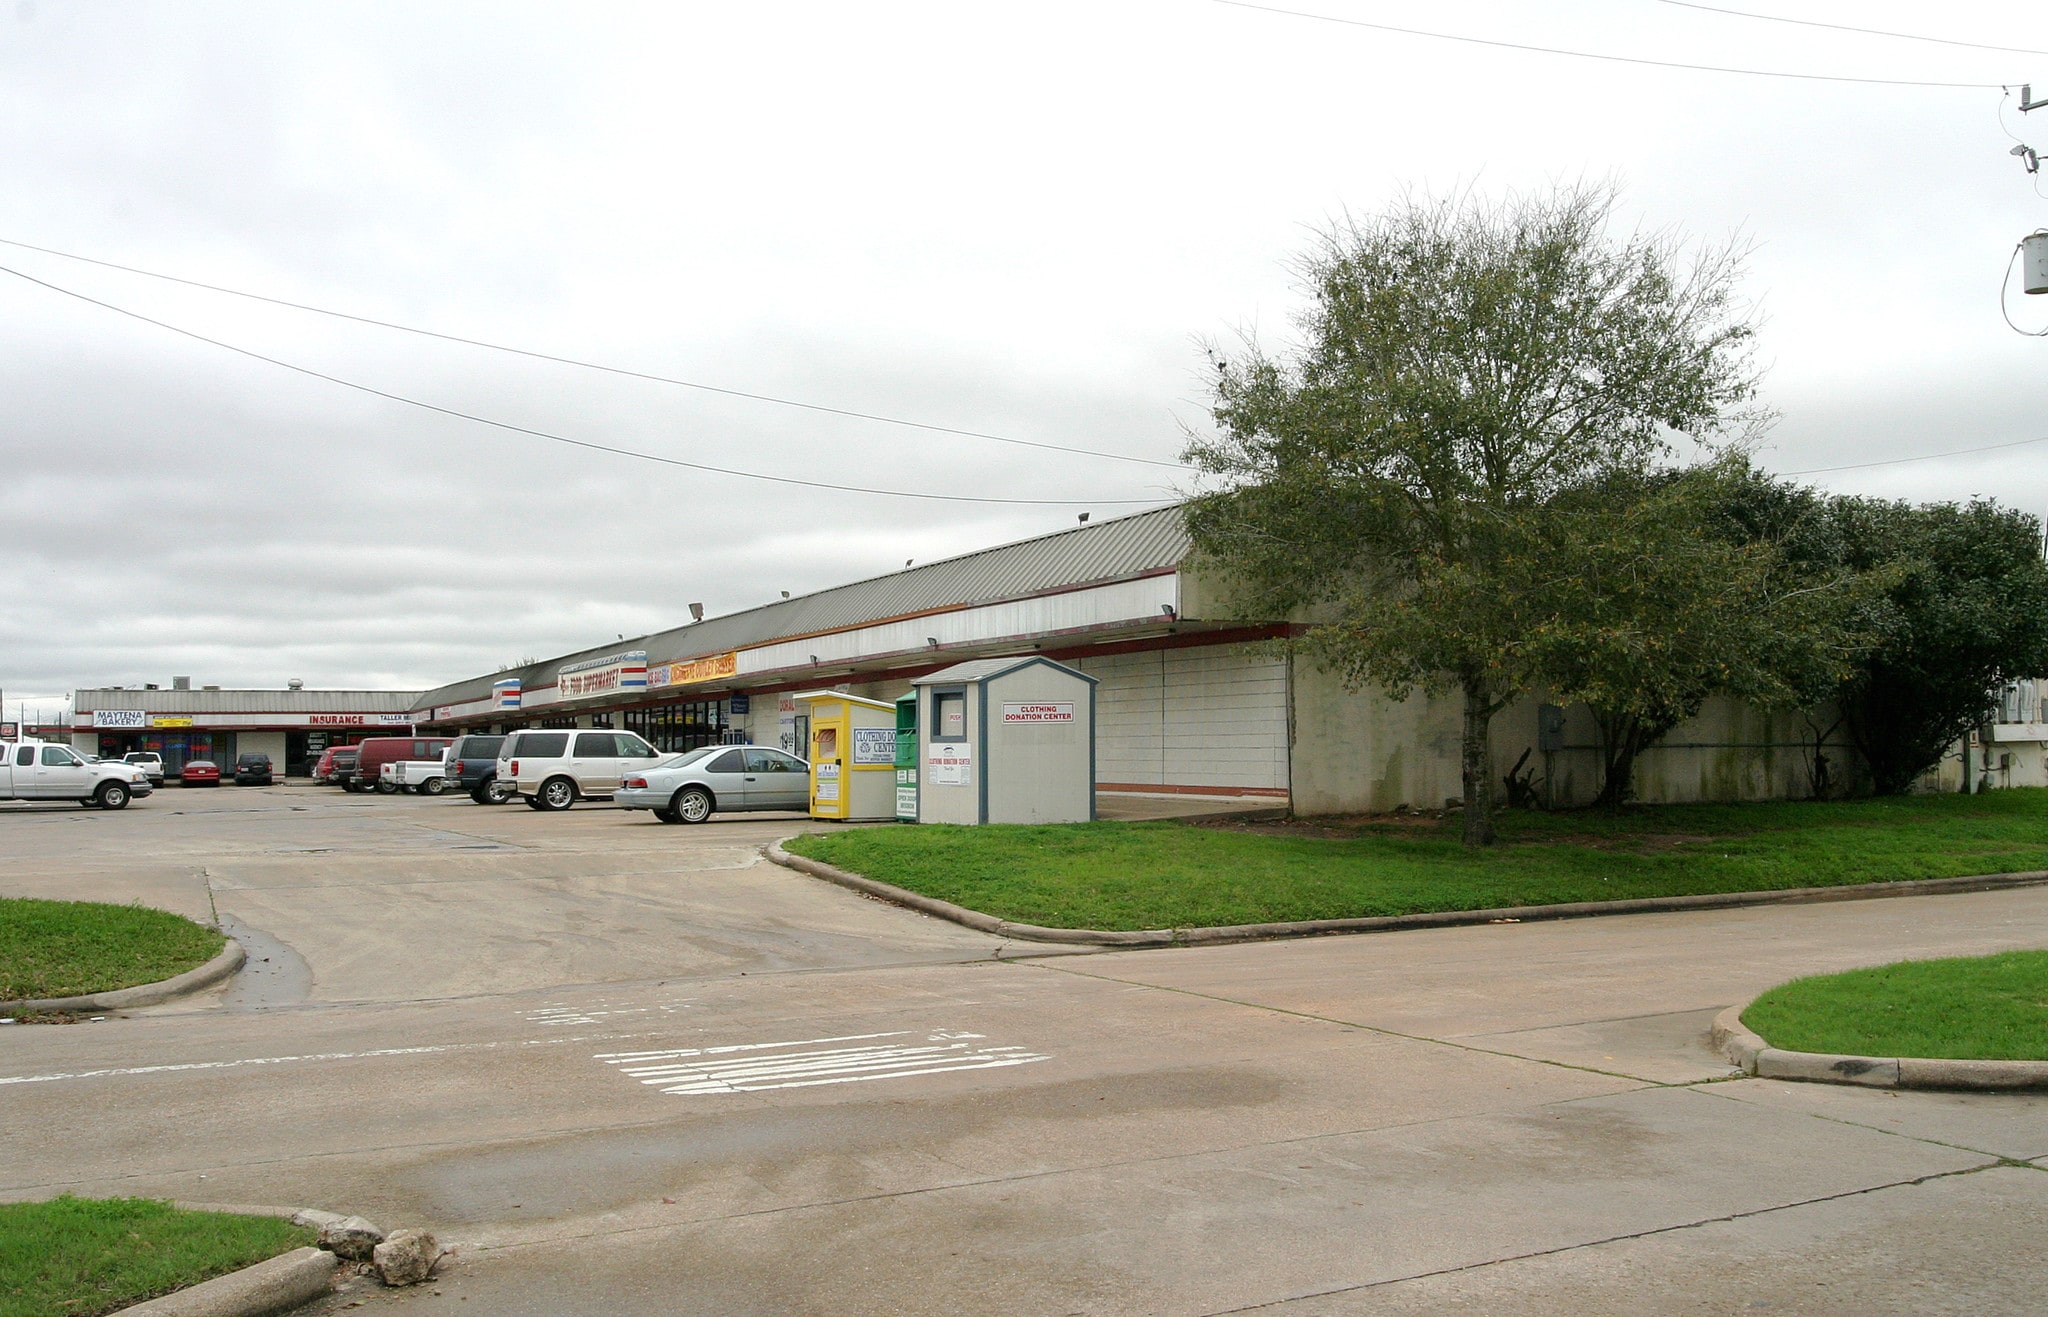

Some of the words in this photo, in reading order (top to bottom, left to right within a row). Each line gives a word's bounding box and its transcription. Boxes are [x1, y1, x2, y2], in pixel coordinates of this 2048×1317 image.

[780, 699, 794, 711] DORAL
[98, 711, 142, 719] MAYTENA
[309, 715, 364, 724] INSURANCE
[856, 731, 887, 742] CLOTHING
[874, 743, 896, 752] CENTE
